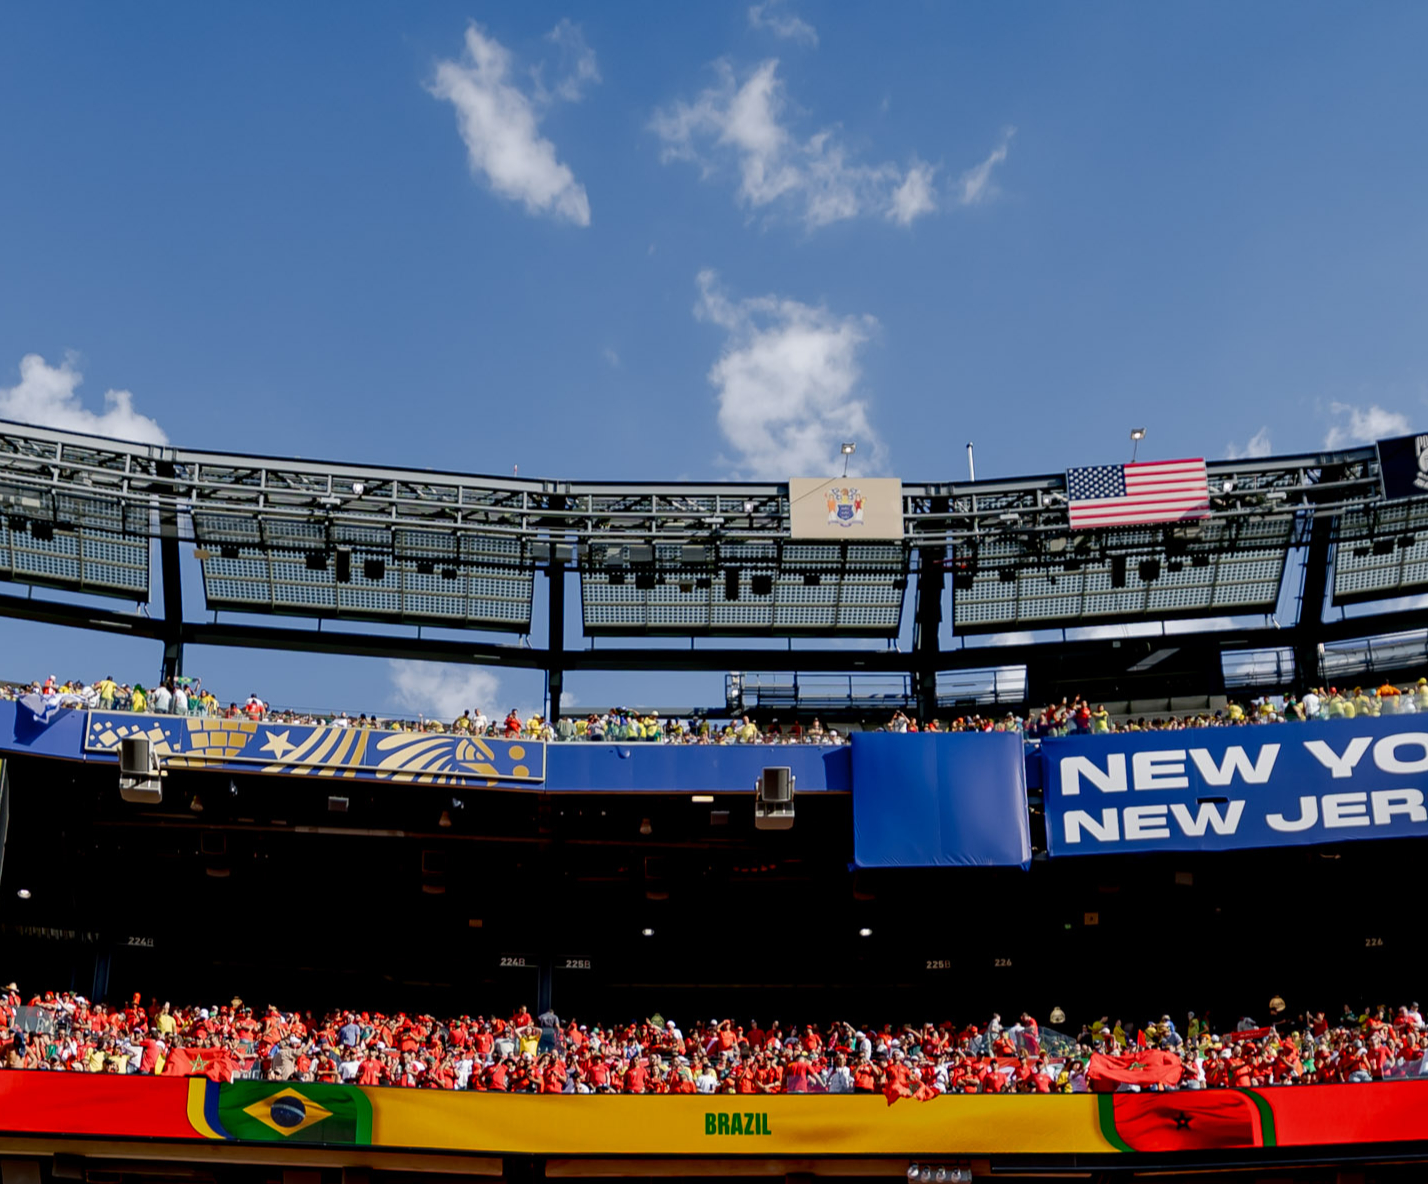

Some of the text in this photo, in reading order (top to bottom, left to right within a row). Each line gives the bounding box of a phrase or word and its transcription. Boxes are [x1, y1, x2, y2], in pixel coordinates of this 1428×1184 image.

[1060, 741, 1281, 797] NEW
[1063, 799, 1246, 844] NEW
[994, 958, 1013, 967] 226
[704, 1112, 772, 1137] BRAZIL
